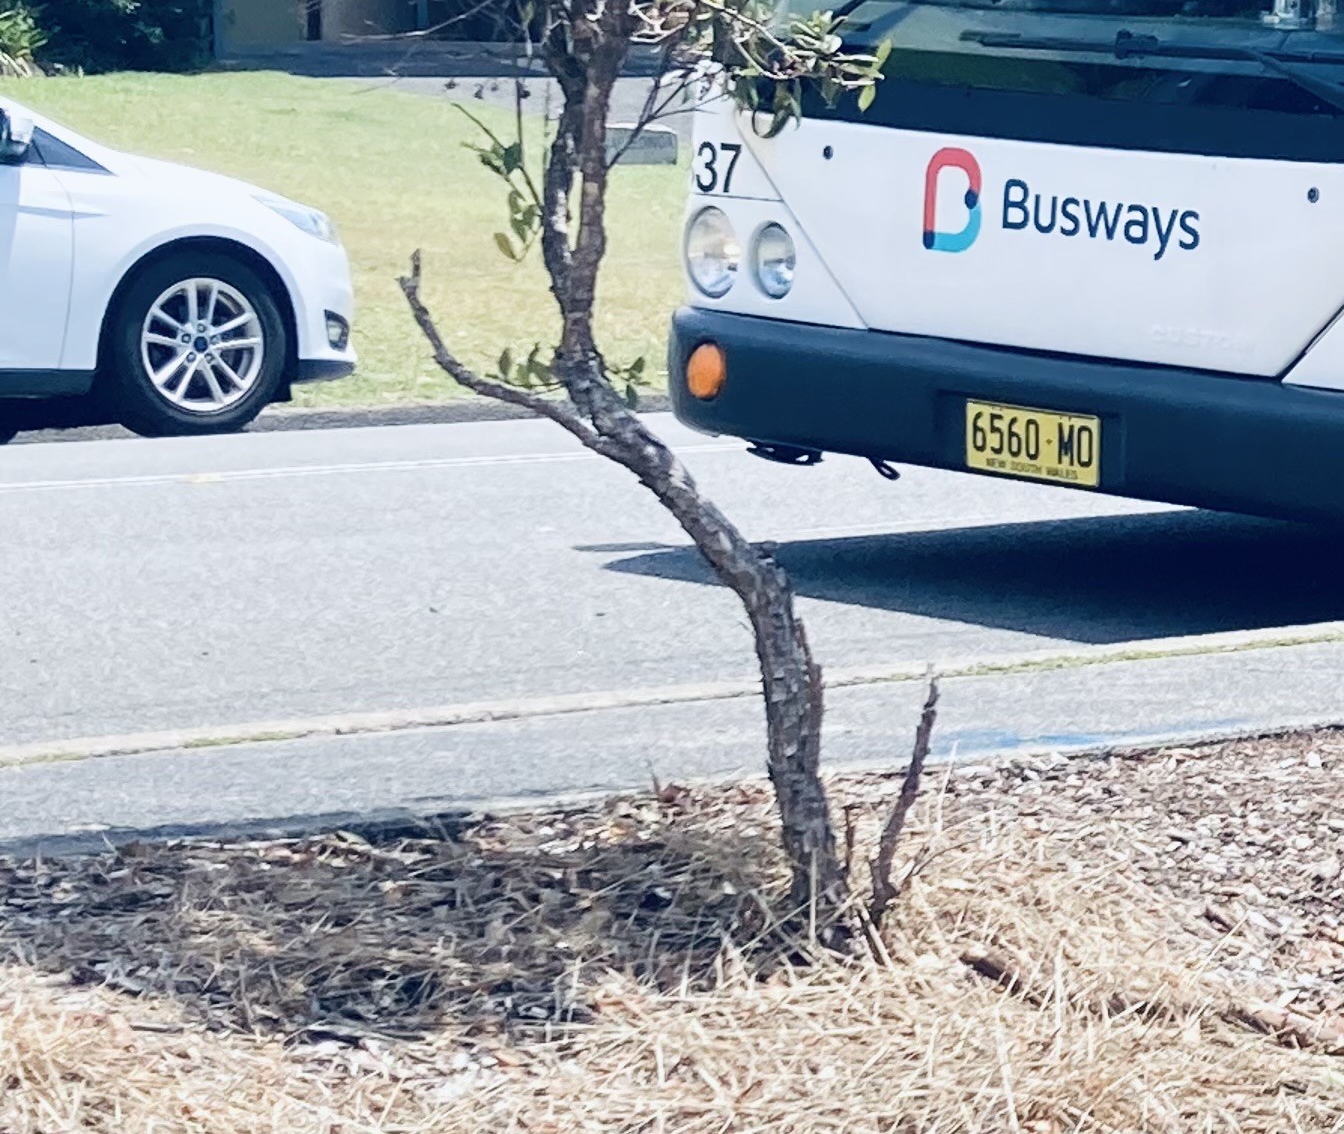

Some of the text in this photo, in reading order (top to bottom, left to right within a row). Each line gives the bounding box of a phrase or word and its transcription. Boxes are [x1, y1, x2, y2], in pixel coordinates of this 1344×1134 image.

[695, 141, 742, 193] 37
[1002, 178, 1200, 261] Busways
[1150, 323, 1260, 353] CUSTO
[972, 411, 1094, 468] 6560 MO
